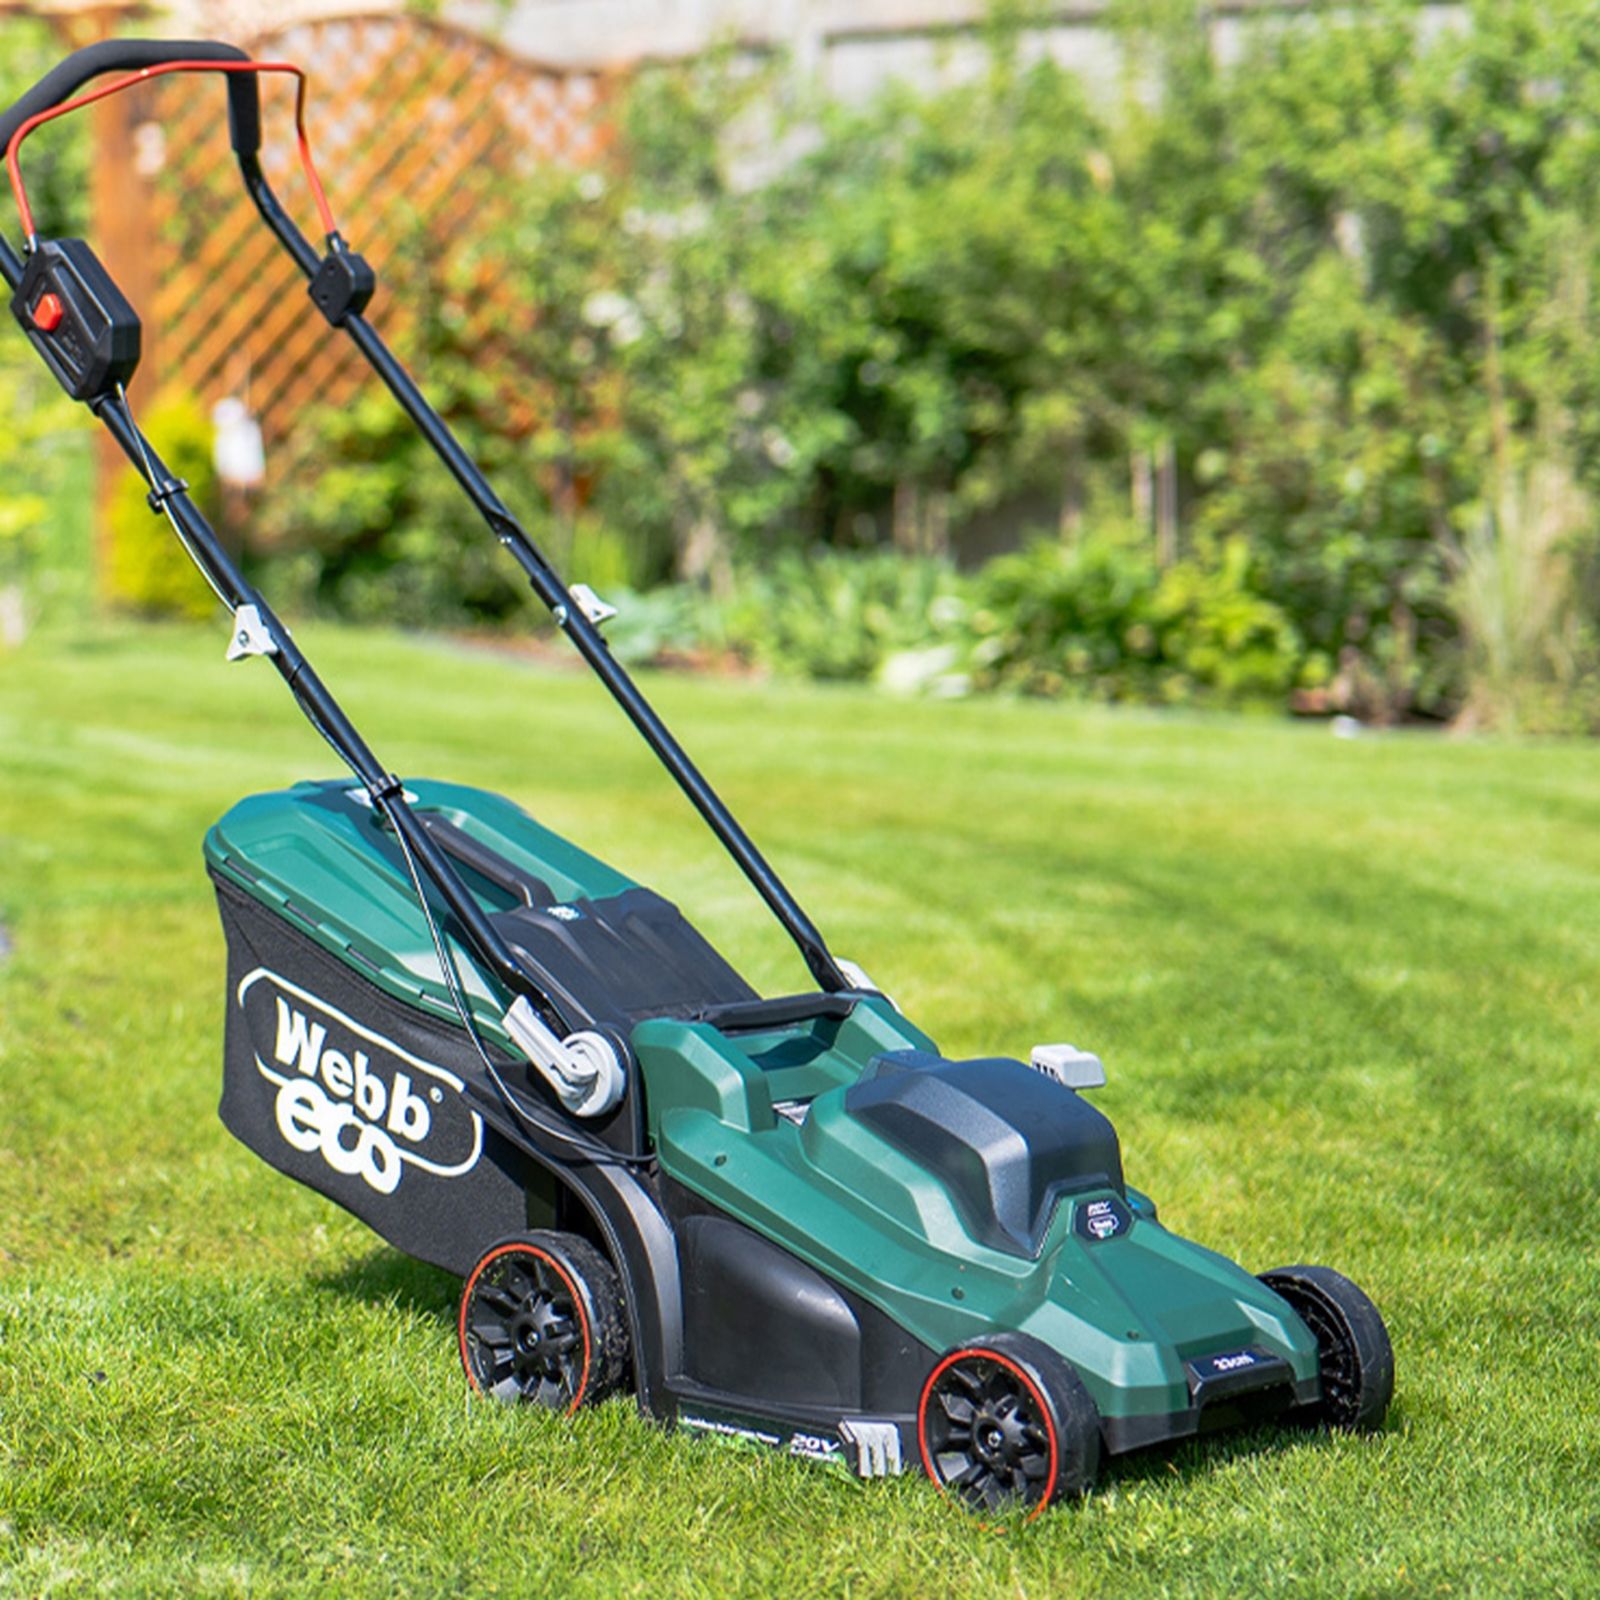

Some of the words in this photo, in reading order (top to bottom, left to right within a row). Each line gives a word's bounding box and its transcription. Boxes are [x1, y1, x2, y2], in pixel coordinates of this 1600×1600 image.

[275, 996, 430, 1142] Webb
[275, 1078, 402, 1194] eco
[790, 1432, 840, 1452] 20V
